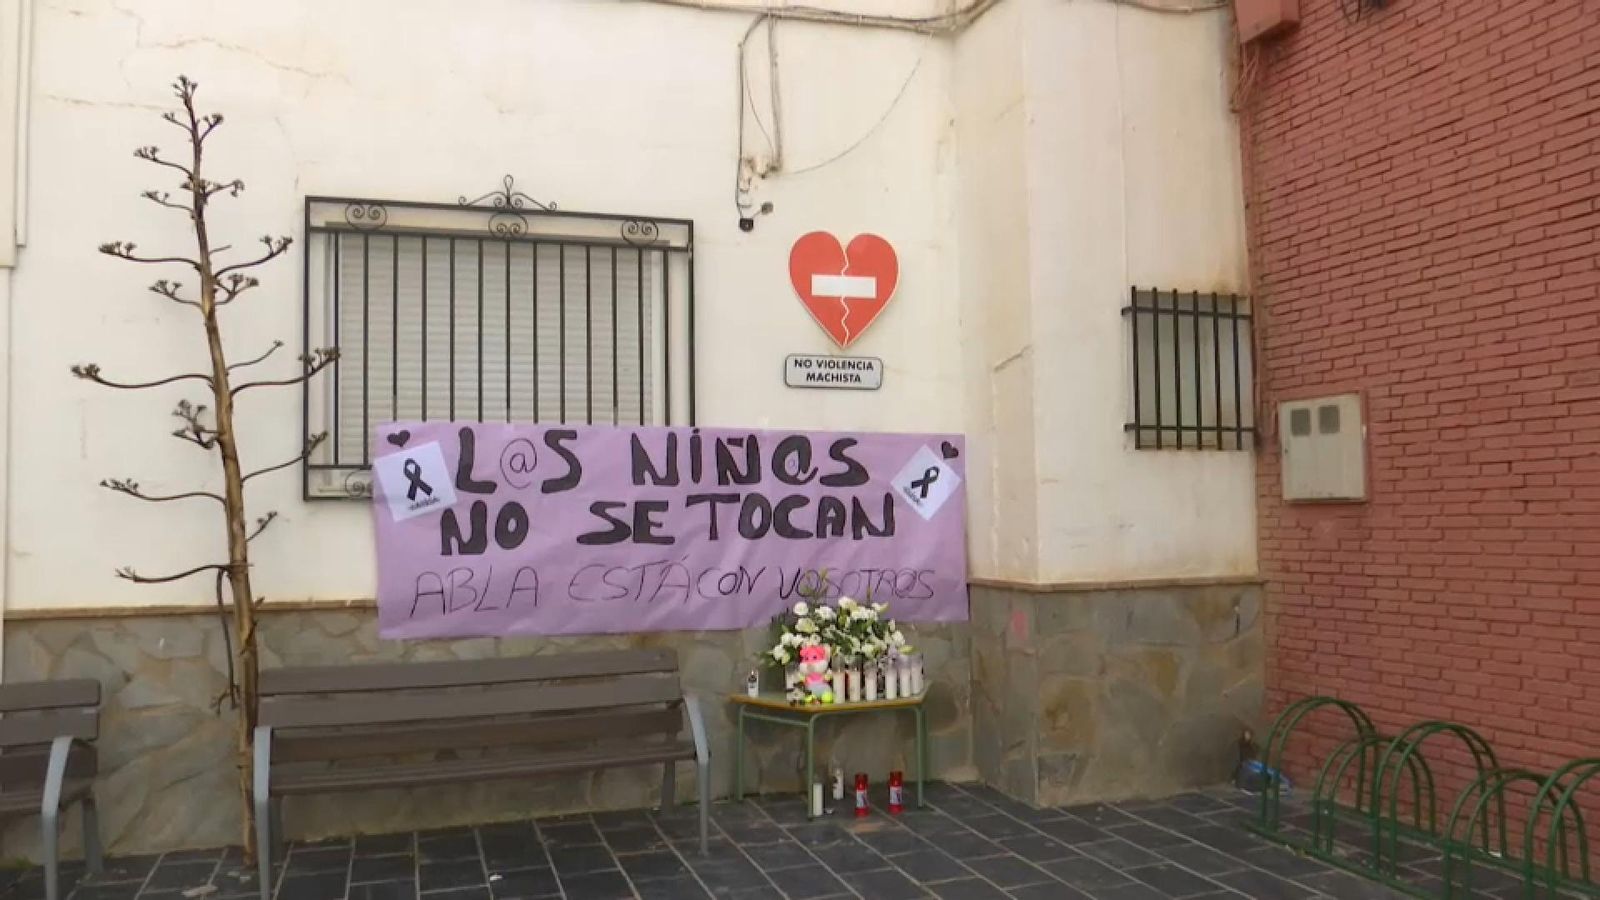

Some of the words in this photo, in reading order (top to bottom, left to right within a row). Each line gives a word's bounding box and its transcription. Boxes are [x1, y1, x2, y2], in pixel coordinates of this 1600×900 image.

[794, 359, 813, 369] NO
[816, 360, 875, 372] VIOLENCIA
[806, 373, 862, 383] MACHISTA
[456, 426, 582, 494] L@S
[440, 500, 529, 556] NO
[576, 500, 676, 545] SE
[686, 492, 895, 540] TOCAN
[410, 565, 539, 618] ABLA
[568, 553, 690, 604] ESTÁ
[697, 565, 766, 600] CON
